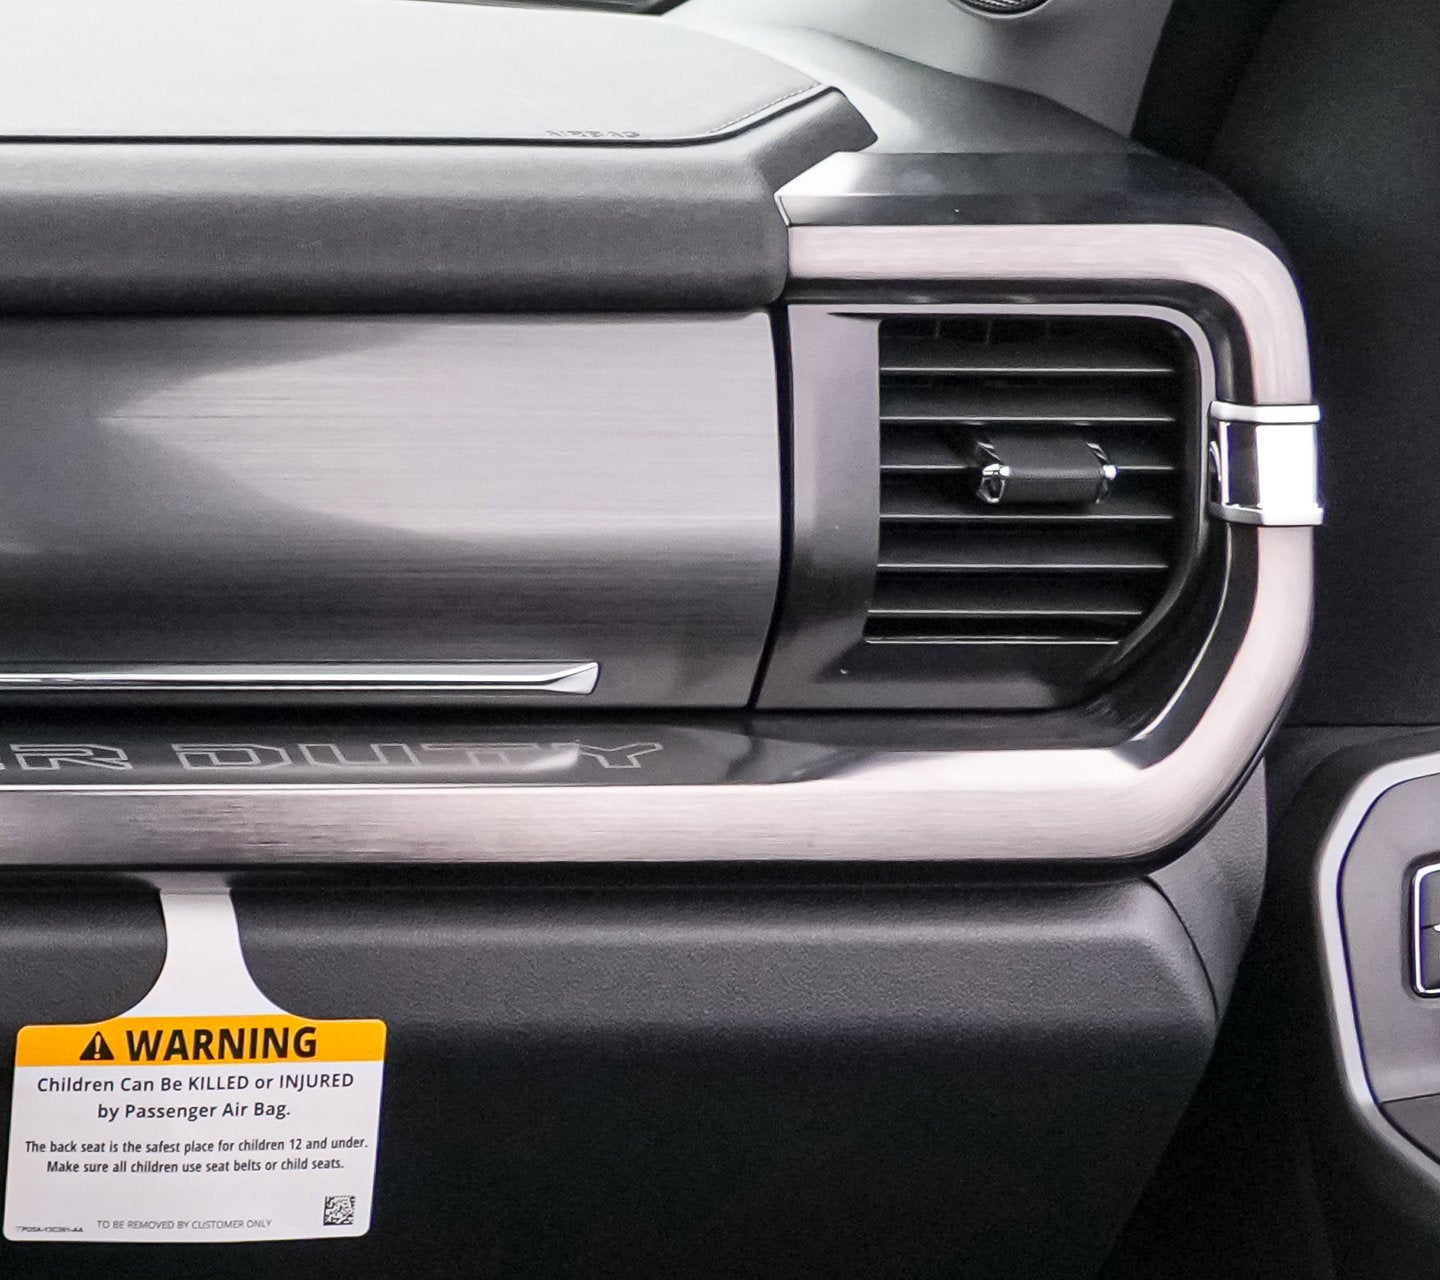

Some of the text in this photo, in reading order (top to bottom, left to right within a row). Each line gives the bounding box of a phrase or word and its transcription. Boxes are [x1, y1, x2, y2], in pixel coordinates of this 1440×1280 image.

[172, 741, 664, 772] DUTY
[125, 1026, 317, 1061] WARNING
[36, 1073, 354, 1093] Children Can Be KILLED or INJURED
[97, 1101, 291, 1122] by Passenger Air Bag.
[25, 1136, 368, 1156] The back seat is the safest place for children 12 and under.
[46, 1158, 345, 1173] Make sure all children use seat belts or child seats.
[97, 1219, 272, 1230] TO BE REMOVED BY CUSTOMER ONLY
